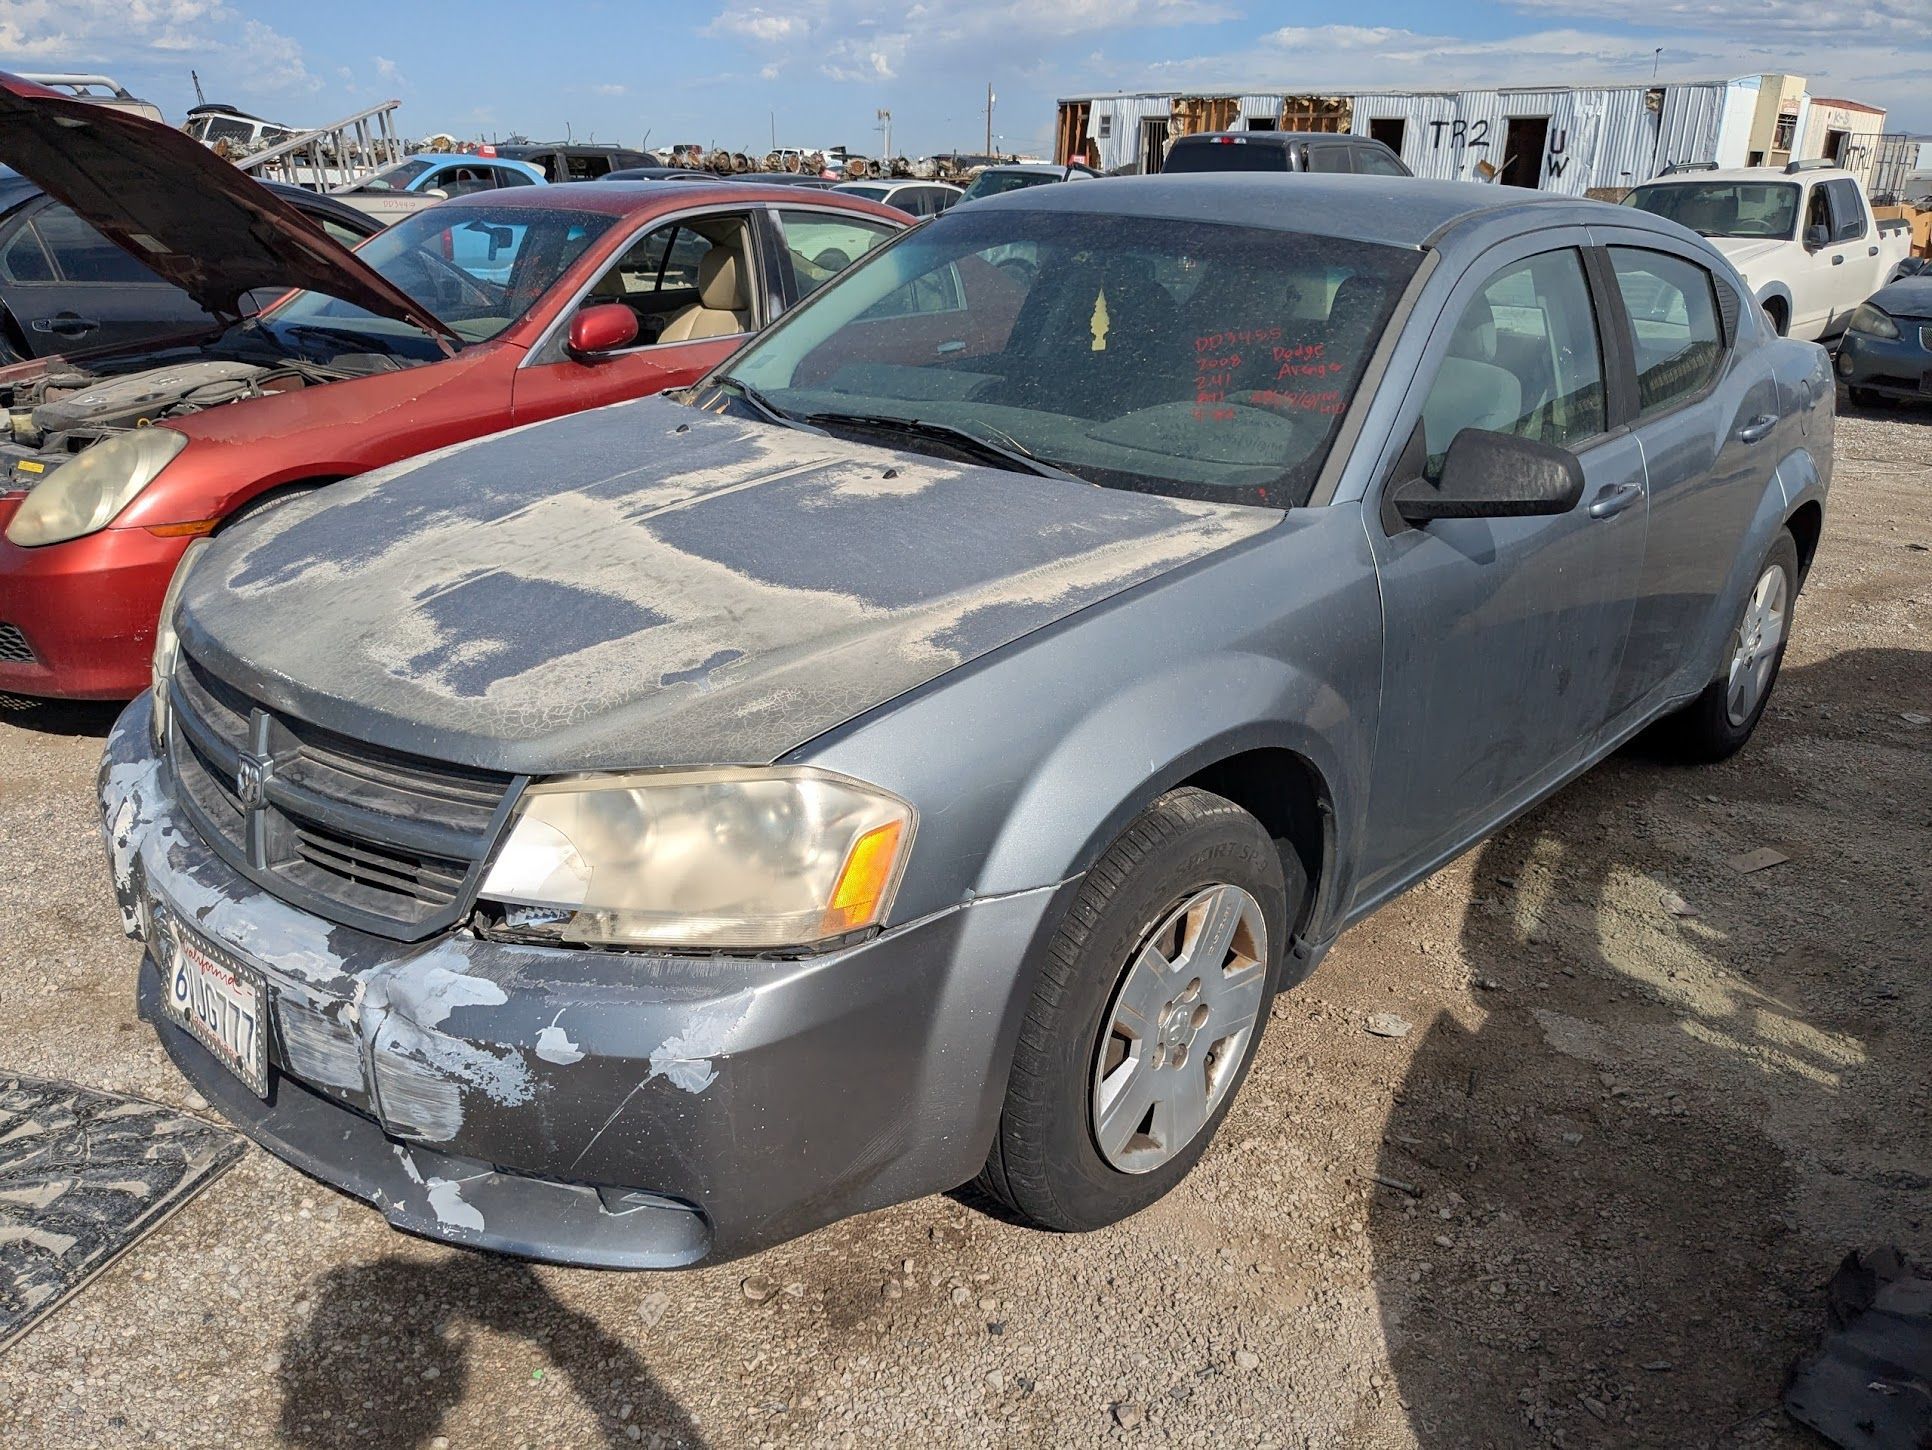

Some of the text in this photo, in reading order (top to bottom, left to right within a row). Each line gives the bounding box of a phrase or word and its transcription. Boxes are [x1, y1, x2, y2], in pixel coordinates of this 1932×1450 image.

[1429, 119, 1490, 149] TR2
[1550, 128, 1566, 154] U
[1547, 153, 1570, 178] W
